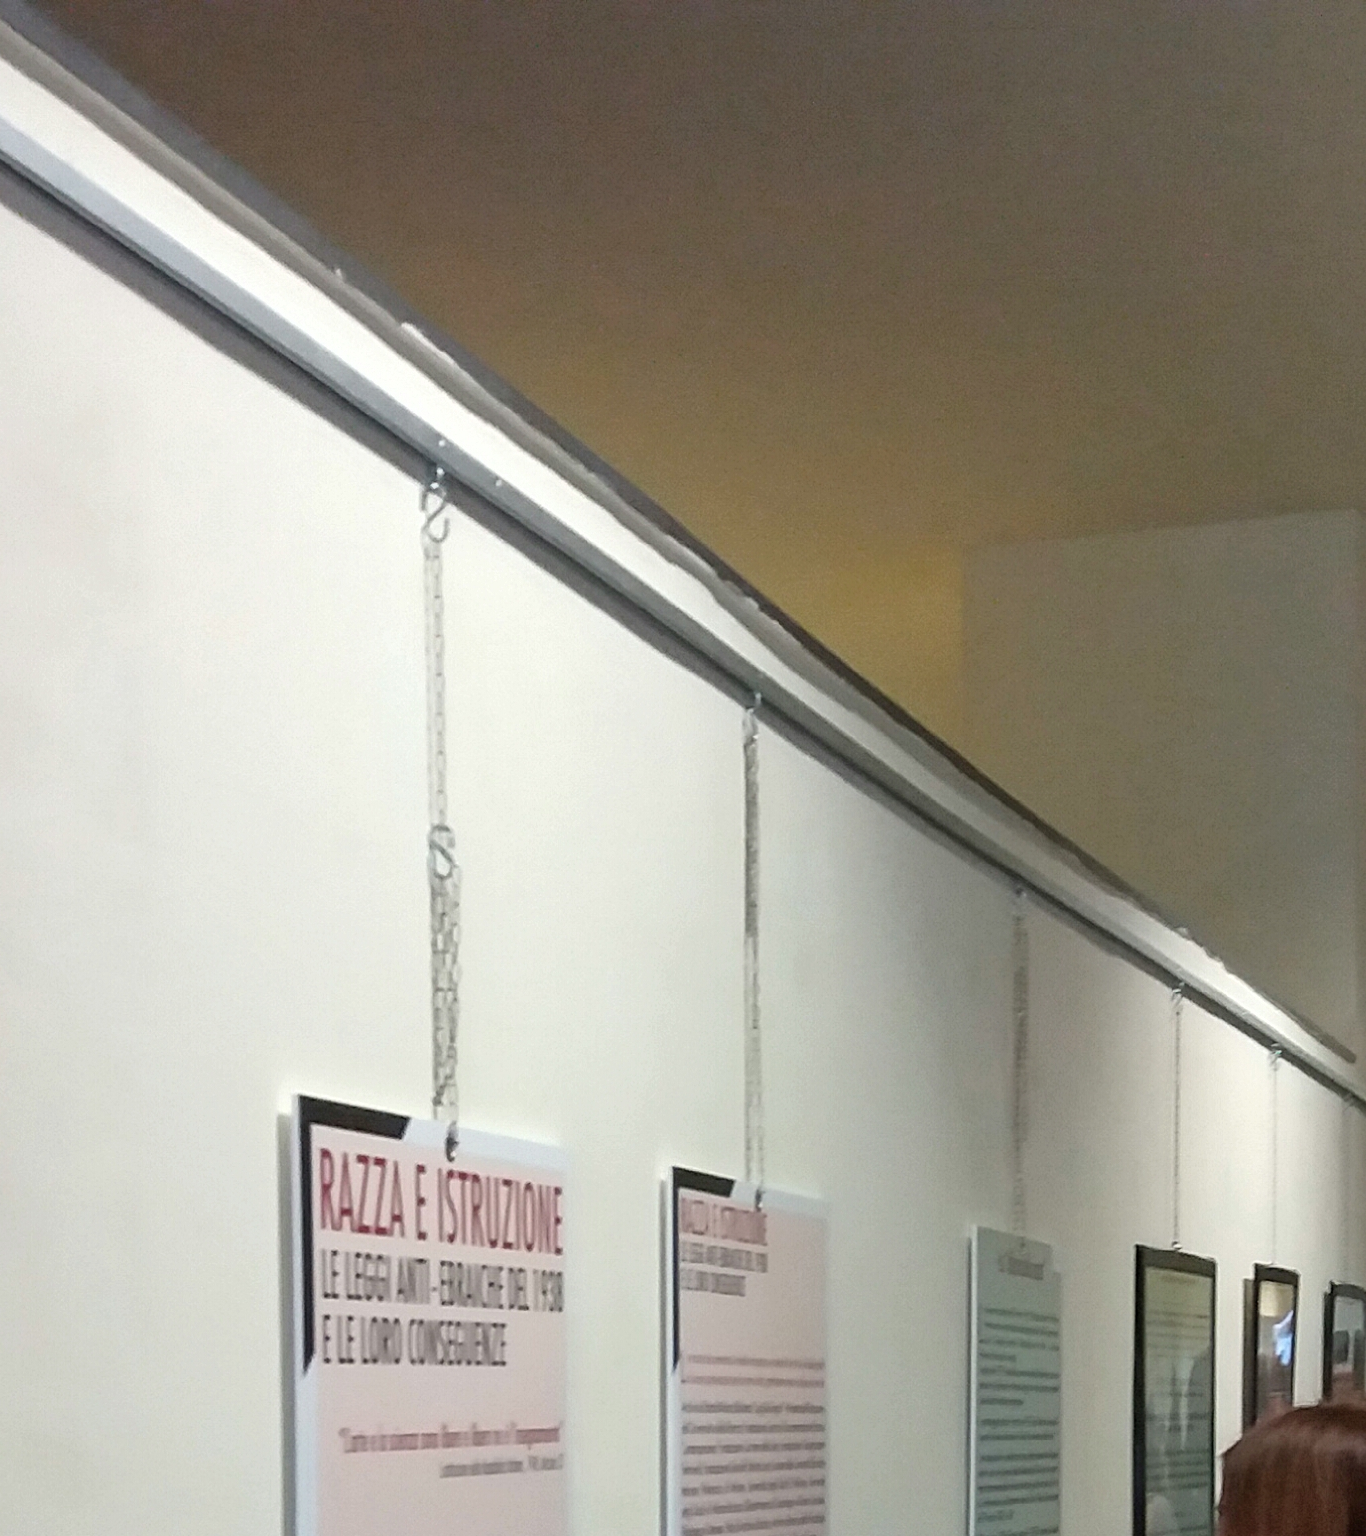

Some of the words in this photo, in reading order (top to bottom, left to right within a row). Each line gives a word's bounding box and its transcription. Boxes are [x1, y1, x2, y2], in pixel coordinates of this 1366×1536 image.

[320, 1147, 405, 1239] RAZZA
[415, 1164, 428, 1242] E
[437, 1168, 564, 1256] ISTRUZIONE
[322, 1248, 340, 1300] LE
[345, 1250, 392, 1302] LEGGI
[322, 1313, 332, 1364] E
[337, 1314, 355, 1365] LE
